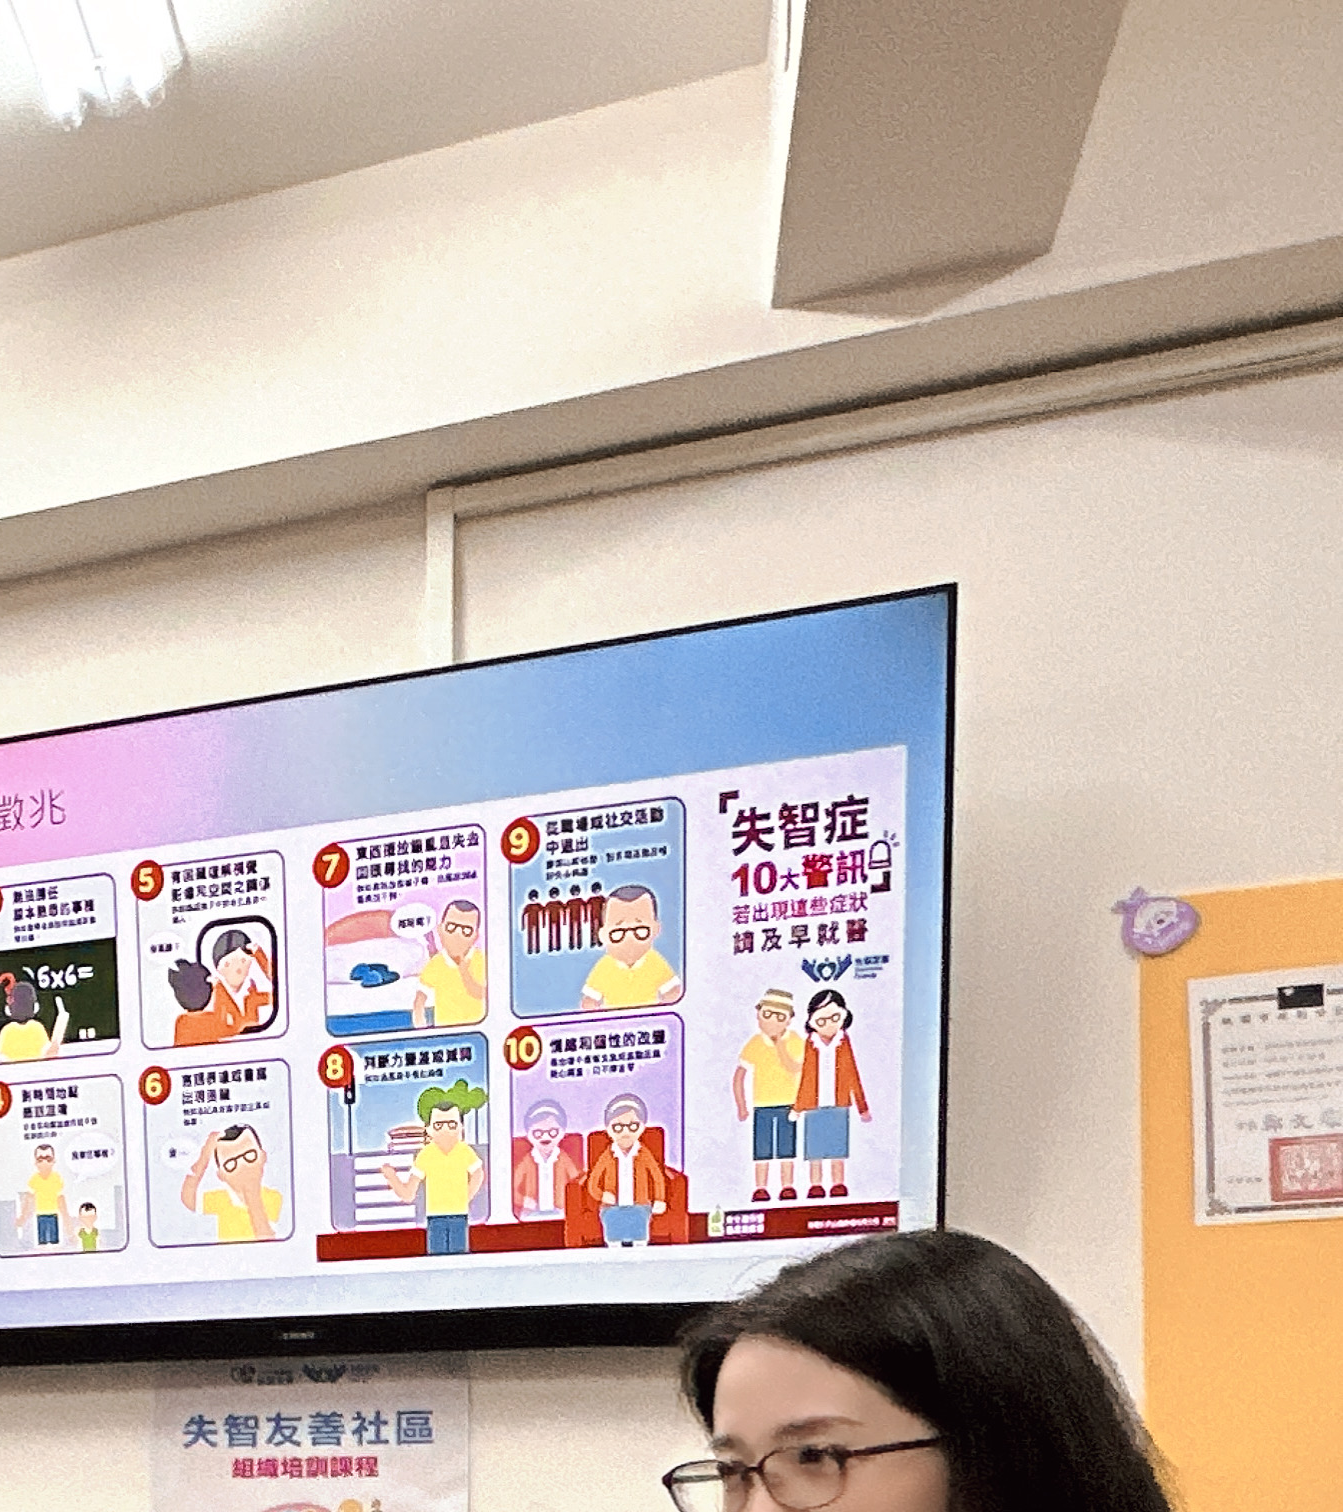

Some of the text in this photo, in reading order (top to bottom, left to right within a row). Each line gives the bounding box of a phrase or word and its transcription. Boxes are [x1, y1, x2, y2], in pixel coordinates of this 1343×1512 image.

[509, 827, 531, 854] 9
[138, 868, 157, 893] 5
[321, 854, 340, 881] 7
[731, 892, 868, 925] 若出現這些症狀
[505, 1036, 540, 1062] 10
[325, 1053, 344, 1080] 8
[146, 1073, 163, 1098] 6
[182, 1410, 435, 1449] 失智友善社區
[231, 1456, 380, 1479] 組織培訓課程
